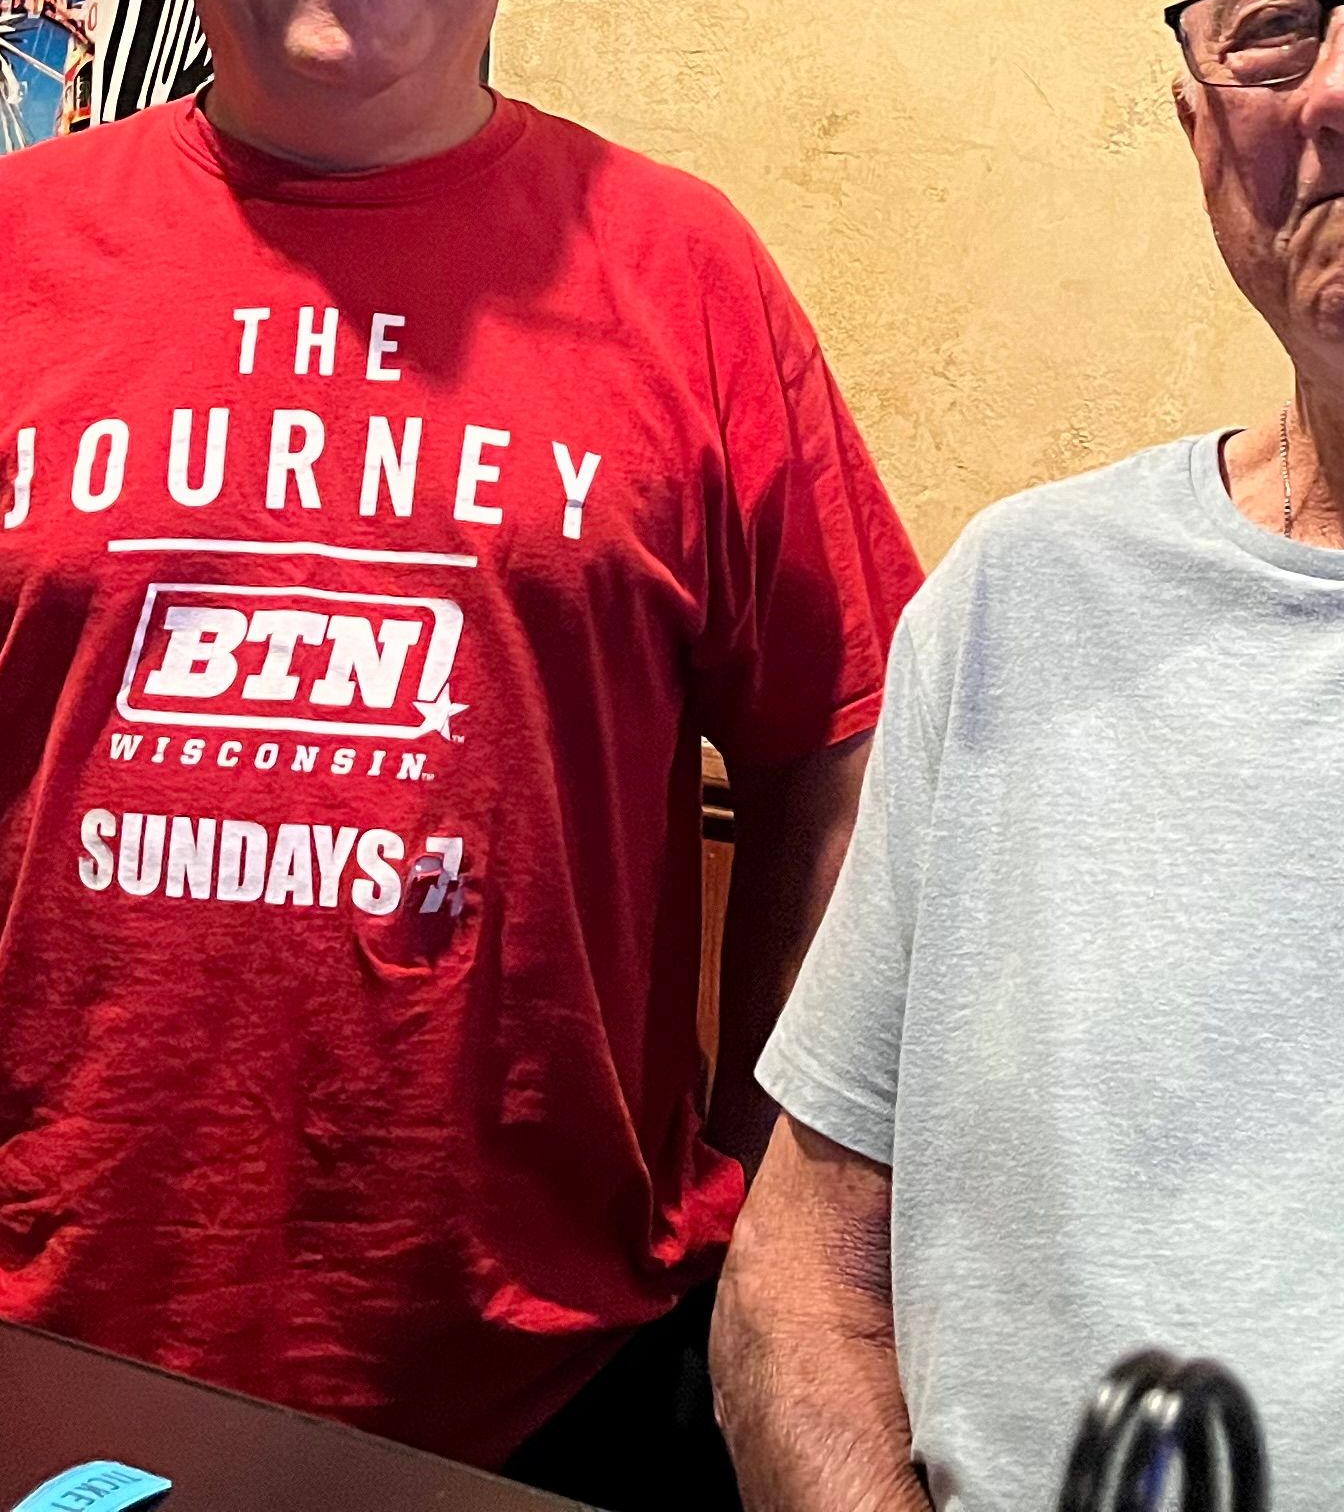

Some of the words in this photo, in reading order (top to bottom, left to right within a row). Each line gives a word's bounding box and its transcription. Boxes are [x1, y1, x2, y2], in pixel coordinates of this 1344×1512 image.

[233, 306, 407, 382] THE
[3, 406, 603, 541] JOURNEY
[77, 808, 406, 917] SUNDAYS
